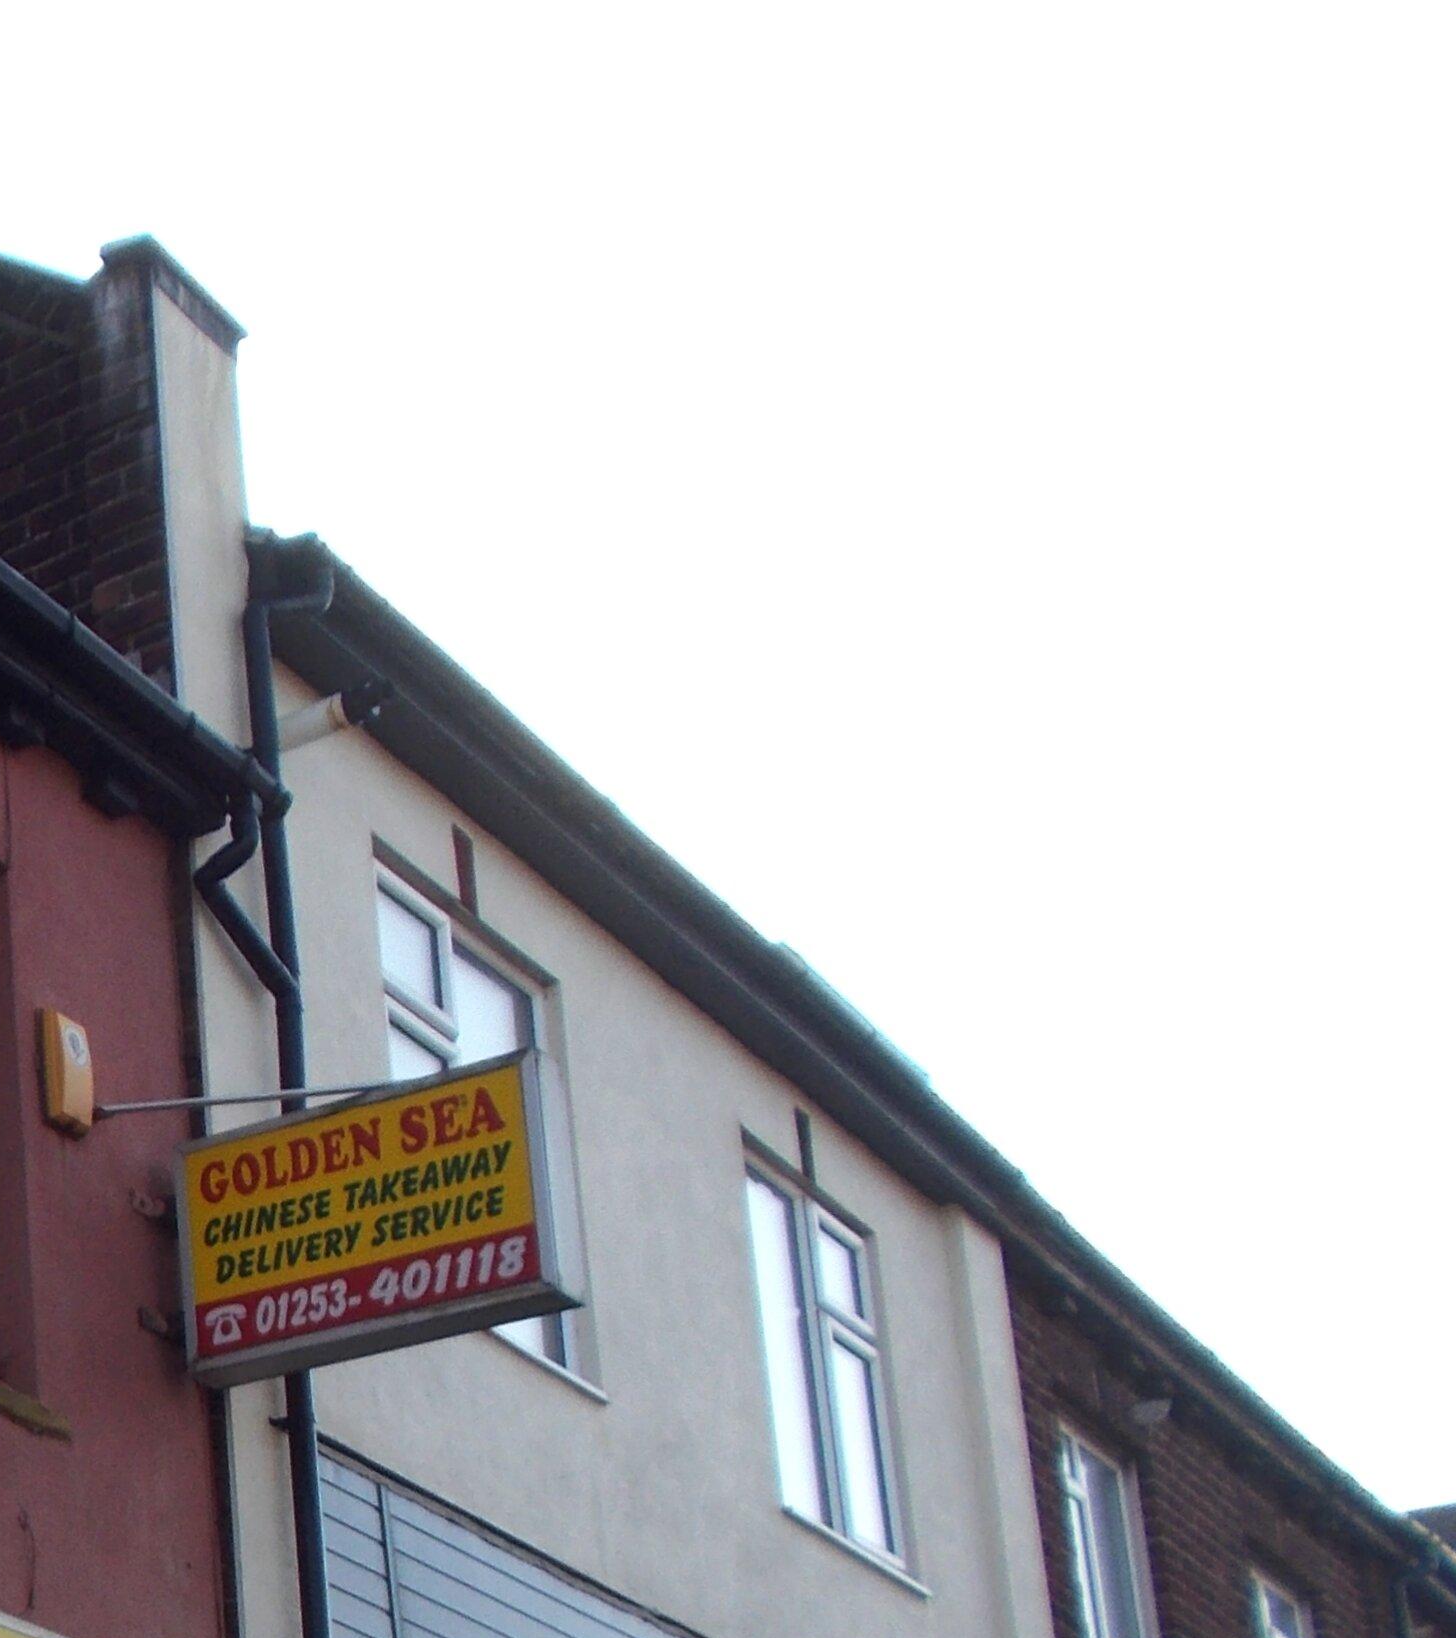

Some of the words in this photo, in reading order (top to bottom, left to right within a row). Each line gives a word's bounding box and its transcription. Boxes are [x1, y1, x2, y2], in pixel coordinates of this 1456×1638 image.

[199, 1118, 382, 1203] GOLDEN
[400, 1086, 506, 1154] SEA
[204, 1189, 332, 1247] CHINESE
[344, 1140, 512, 1213] TAKEAWAY
[216, 1222, 362, 1284] DELIVERY
[372, 1185, 505, 1247] SERVICE
[369, 1235, 528, 1305] 401118
